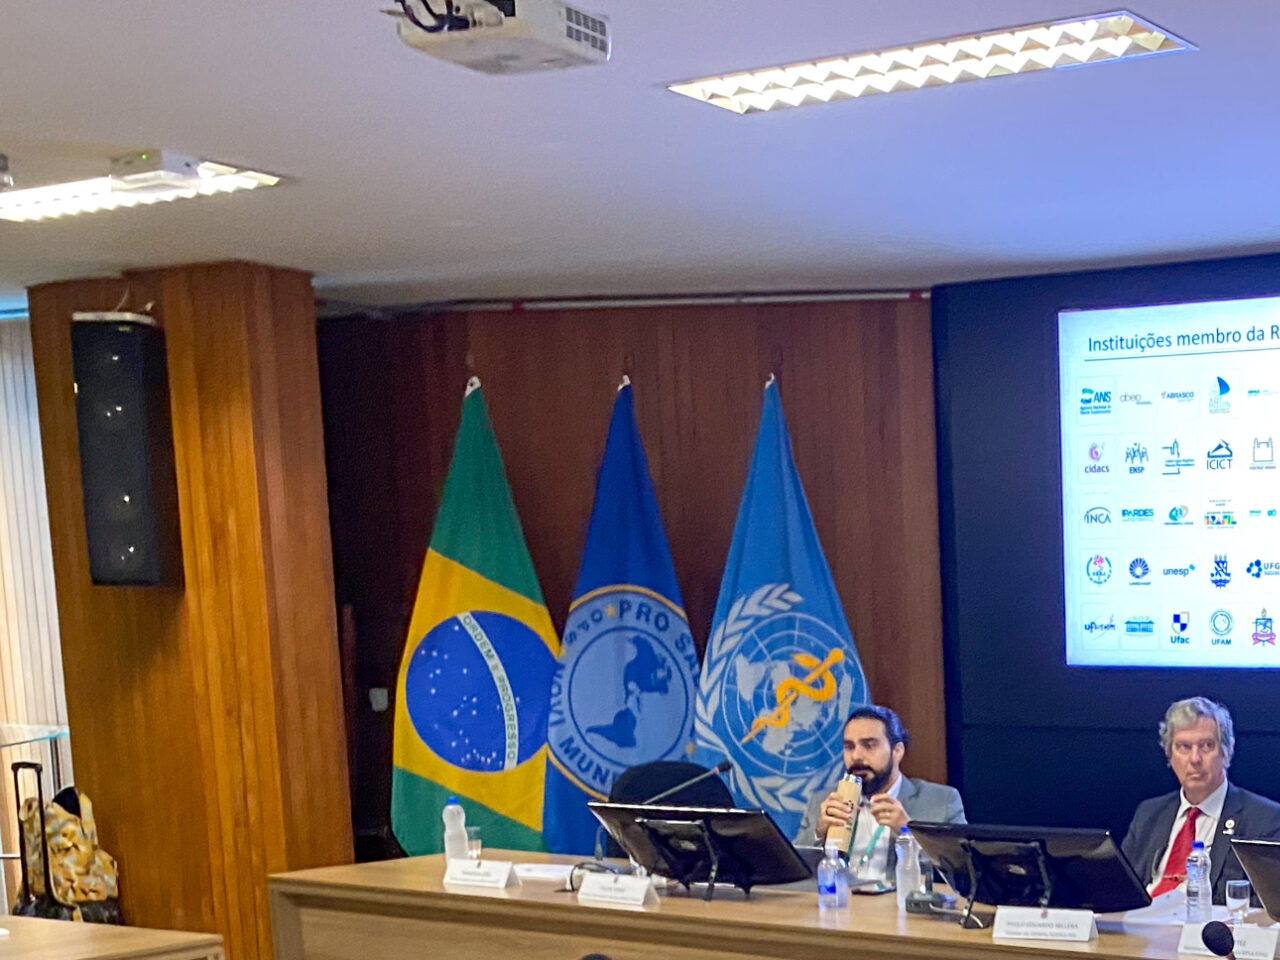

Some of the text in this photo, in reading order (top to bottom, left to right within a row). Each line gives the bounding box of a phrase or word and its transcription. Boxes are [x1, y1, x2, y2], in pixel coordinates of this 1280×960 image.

[1088, 332, 1172, 352] Instituições
[1176, 328, 1242, 347] membro
[1246, 326, 1265, 342] da
[1093, 391, 1111, 403] ANS
[1084, 464, 1110, 474] cidacs
[1206, 459, 1232, 470] ICICT
[1084, 510, 1111, 524] INCA
[1163, 567, 1189, 577] unesp
[1263, 562, 1280, 570] UFG
[618, 599, 670, 633] PRO
[1170, 635, 1190, 644] Ufac
[462, 615, 495, 660] ORDEM
[498, 676, 517, 761] PROGRESSO
[558, 735, 613, 788] MUN
